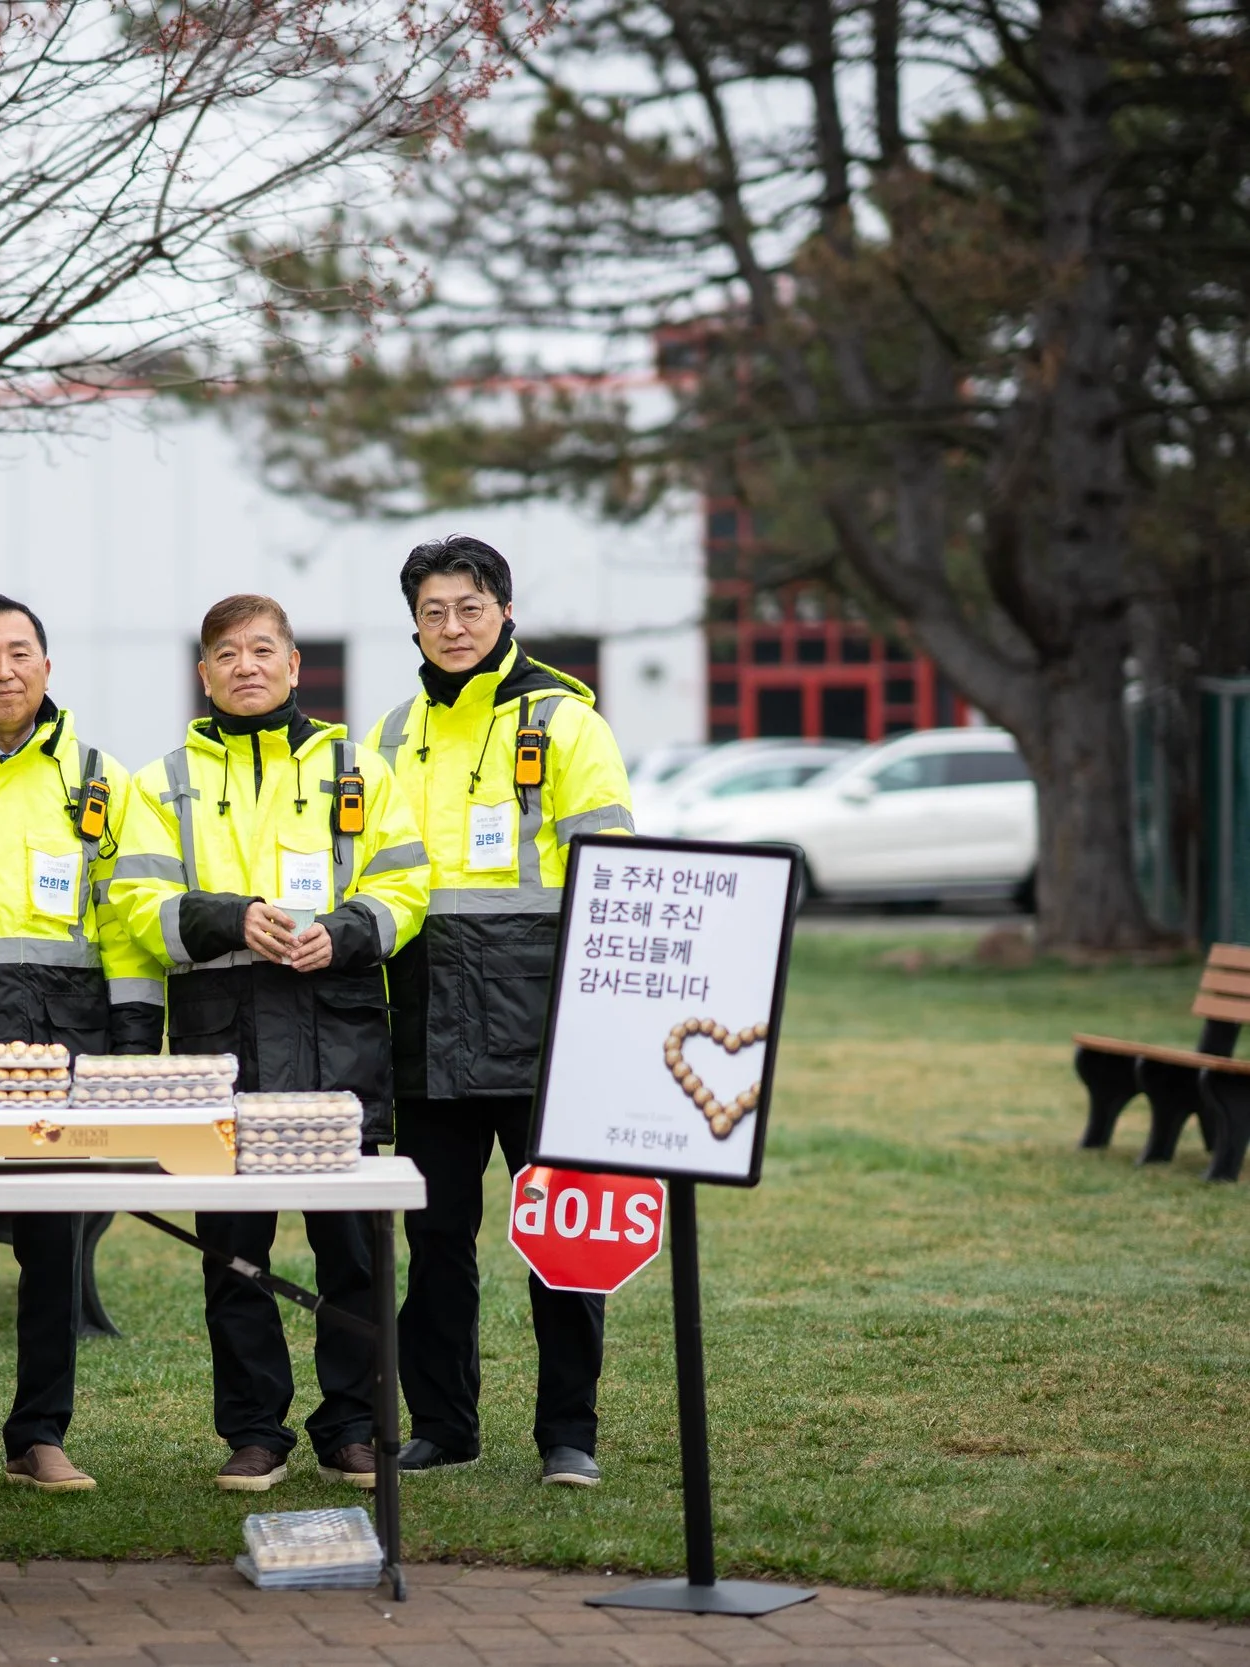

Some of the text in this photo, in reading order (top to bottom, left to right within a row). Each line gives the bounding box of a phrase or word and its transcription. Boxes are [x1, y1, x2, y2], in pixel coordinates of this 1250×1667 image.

[475, 831, 504, 846] 김현일
[593, 864, 738, 899] 늘 주차 안내에
[589, 898, 703, 931] 협조해 주신
[584, 933, 693, 966] 성도님들께
[579, 967, 710, 1002] 감사드립니다
[606, 1127, 689, 1152] 주차 안내부
[514, 1187, 659, 1245] STOP
